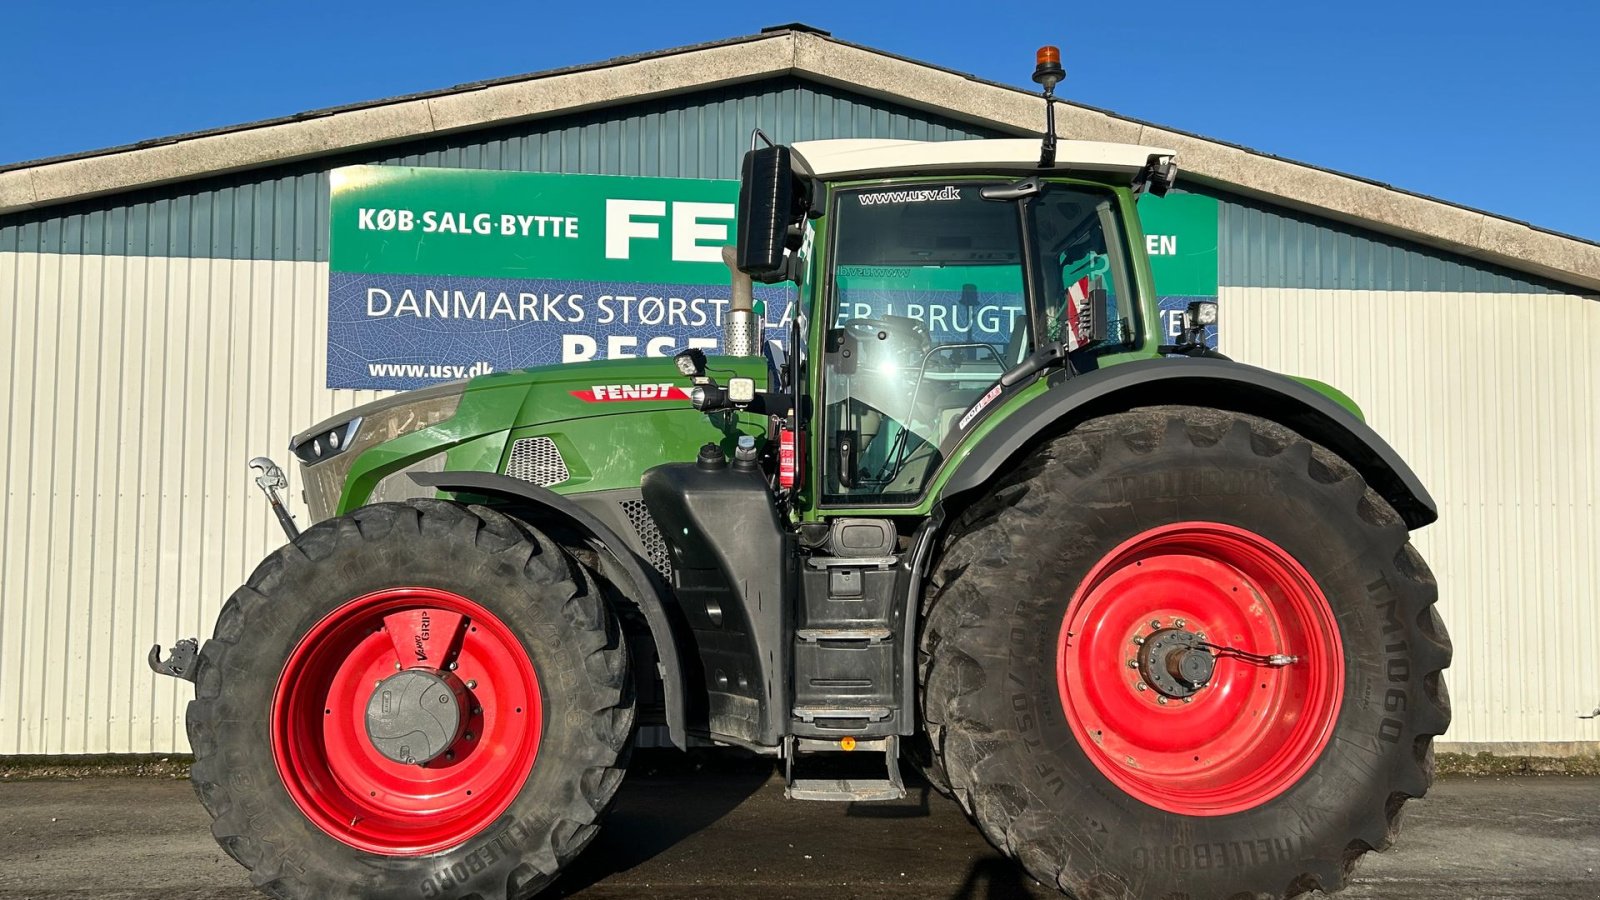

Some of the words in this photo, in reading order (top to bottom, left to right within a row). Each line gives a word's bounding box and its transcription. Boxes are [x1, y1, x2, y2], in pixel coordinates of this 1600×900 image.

[858, 186, 961, 205] www.usv.dk
[605, 198, 735, 262] FE
[1143, 233, 1177, 256] EN
[367, 288, 584, 322] DANMARKS
[597, 294, 730, 328] STØRST
[907, 304, 1024, 335] BRUGT
[368, 361, 494, 379] www.usv.dk
[591, 382, 675, 400] FENDT
[421, 611, 431, 641] GRIP
